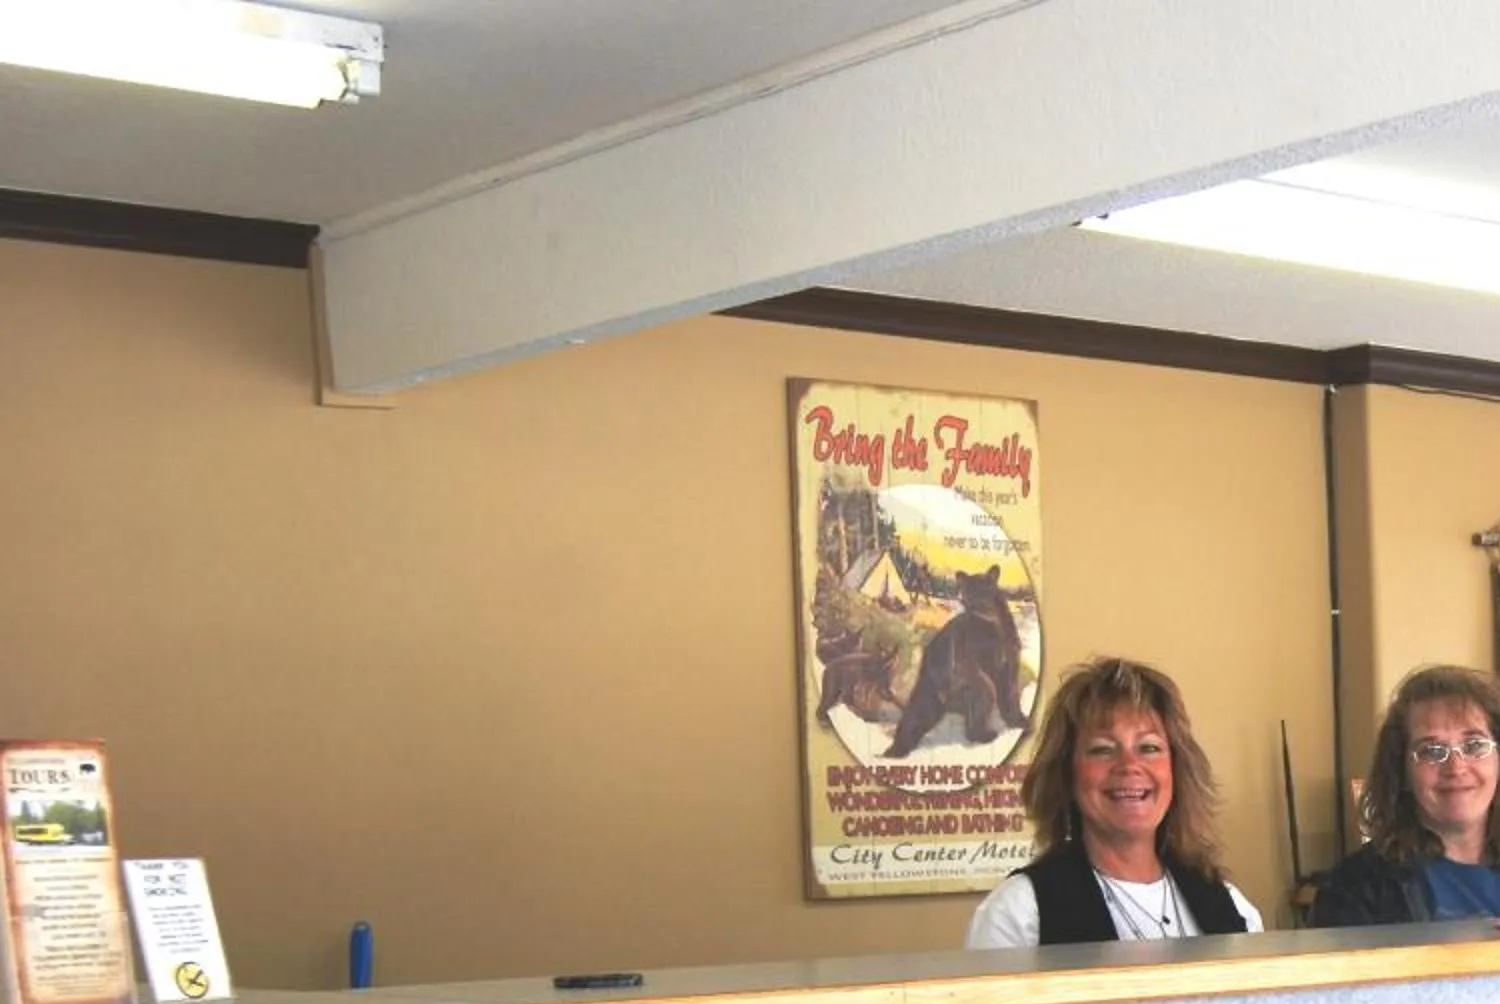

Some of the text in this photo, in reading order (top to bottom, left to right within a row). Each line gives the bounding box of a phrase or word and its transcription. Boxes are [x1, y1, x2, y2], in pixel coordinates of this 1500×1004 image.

[805, 405, 1032, 498] Bring the Family
[921, 764, 964, 785] HOME
[966, 763, 1027, 785] COMFOR
[842, 815, 925, 837] CANOEING
[927, 813, 959, 836] AND
[830, 844, 883, 869] City
[892, 842, 967, 863] Center
